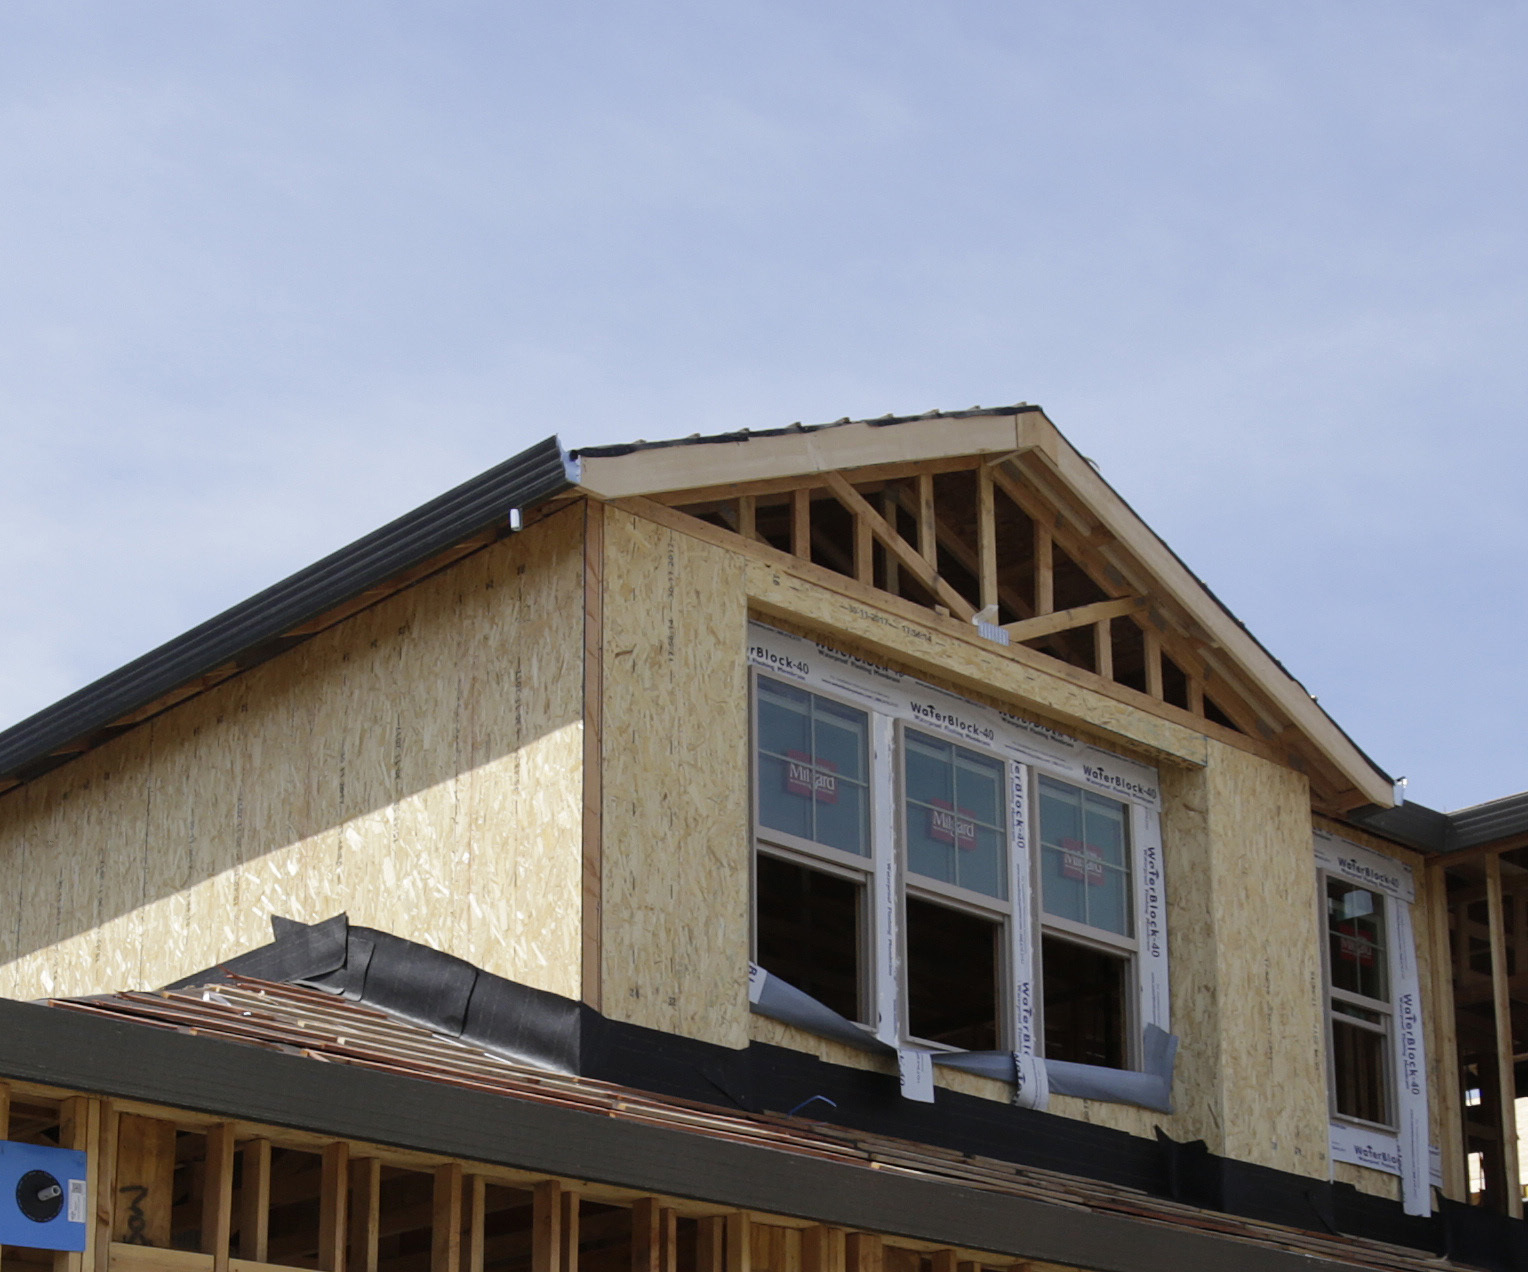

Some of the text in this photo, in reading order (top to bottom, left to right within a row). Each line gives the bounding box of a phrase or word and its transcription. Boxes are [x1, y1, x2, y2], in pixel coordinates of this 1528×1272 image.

[749, 646, 809, 675] rBlock-40
[910, 701, 994, 740] WaterBlock-40
[1013, 763, 1025, 849] erBlock-40
[1083, 764, 1157, 799] WaterBlock-40
[1147, 846, 1160, 958] WaterBlock-40
[1403, 993, 1420, 1095] WaterBlock-40
